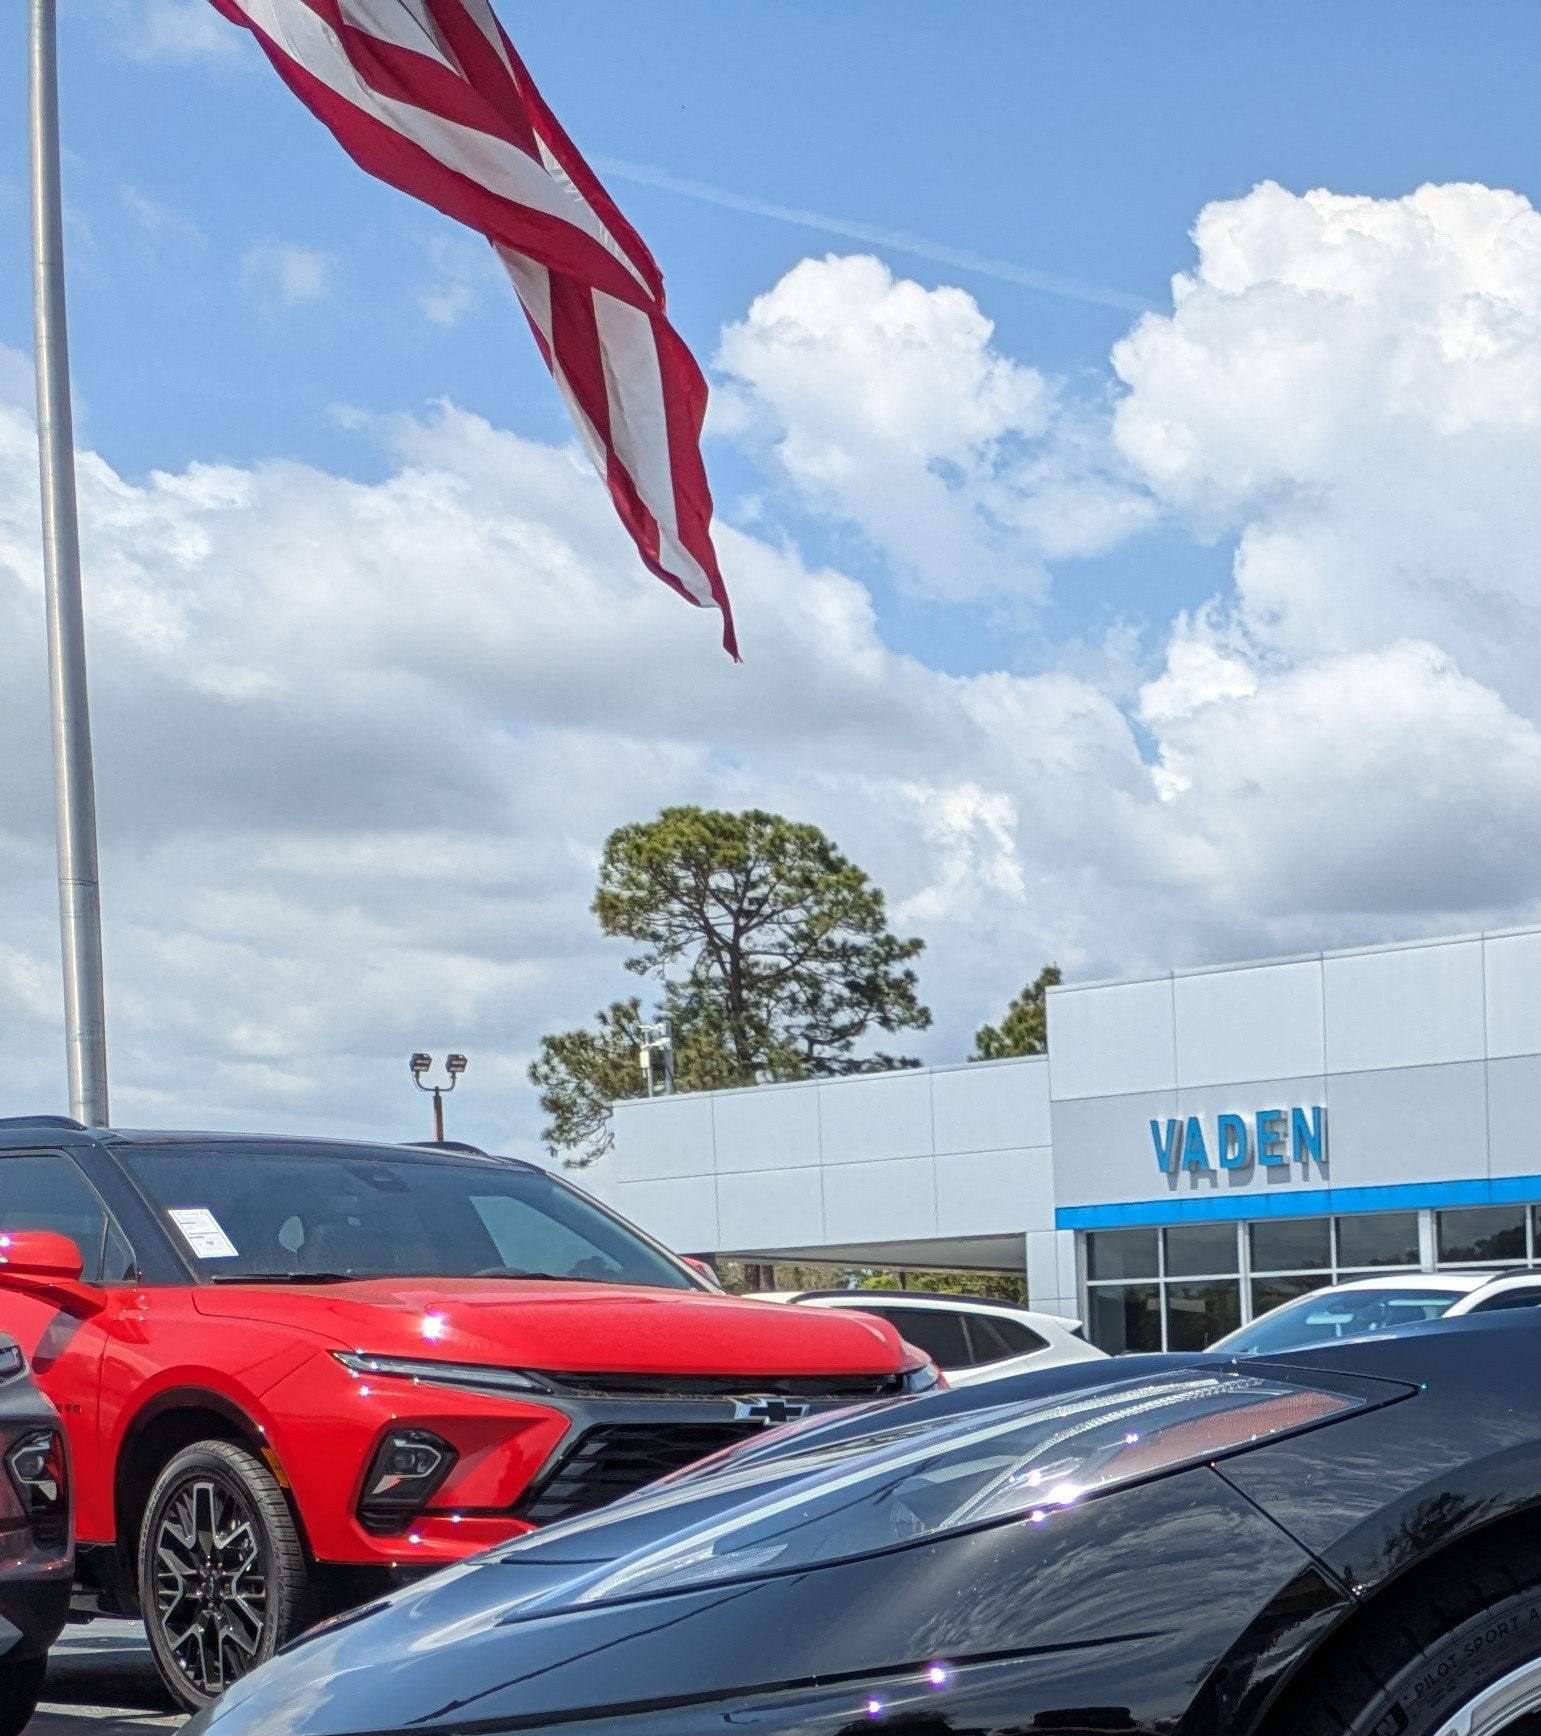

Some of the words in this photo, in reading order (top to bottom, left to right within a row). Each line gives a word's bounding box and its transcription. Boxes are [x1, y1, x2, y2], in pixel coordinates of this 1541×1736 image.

[1150, 1105, 1326, 1174] VADEN
[1413, 1653, 1458, 1699] PILOT
[1463, 1616, 1520, 1657] SPORT
